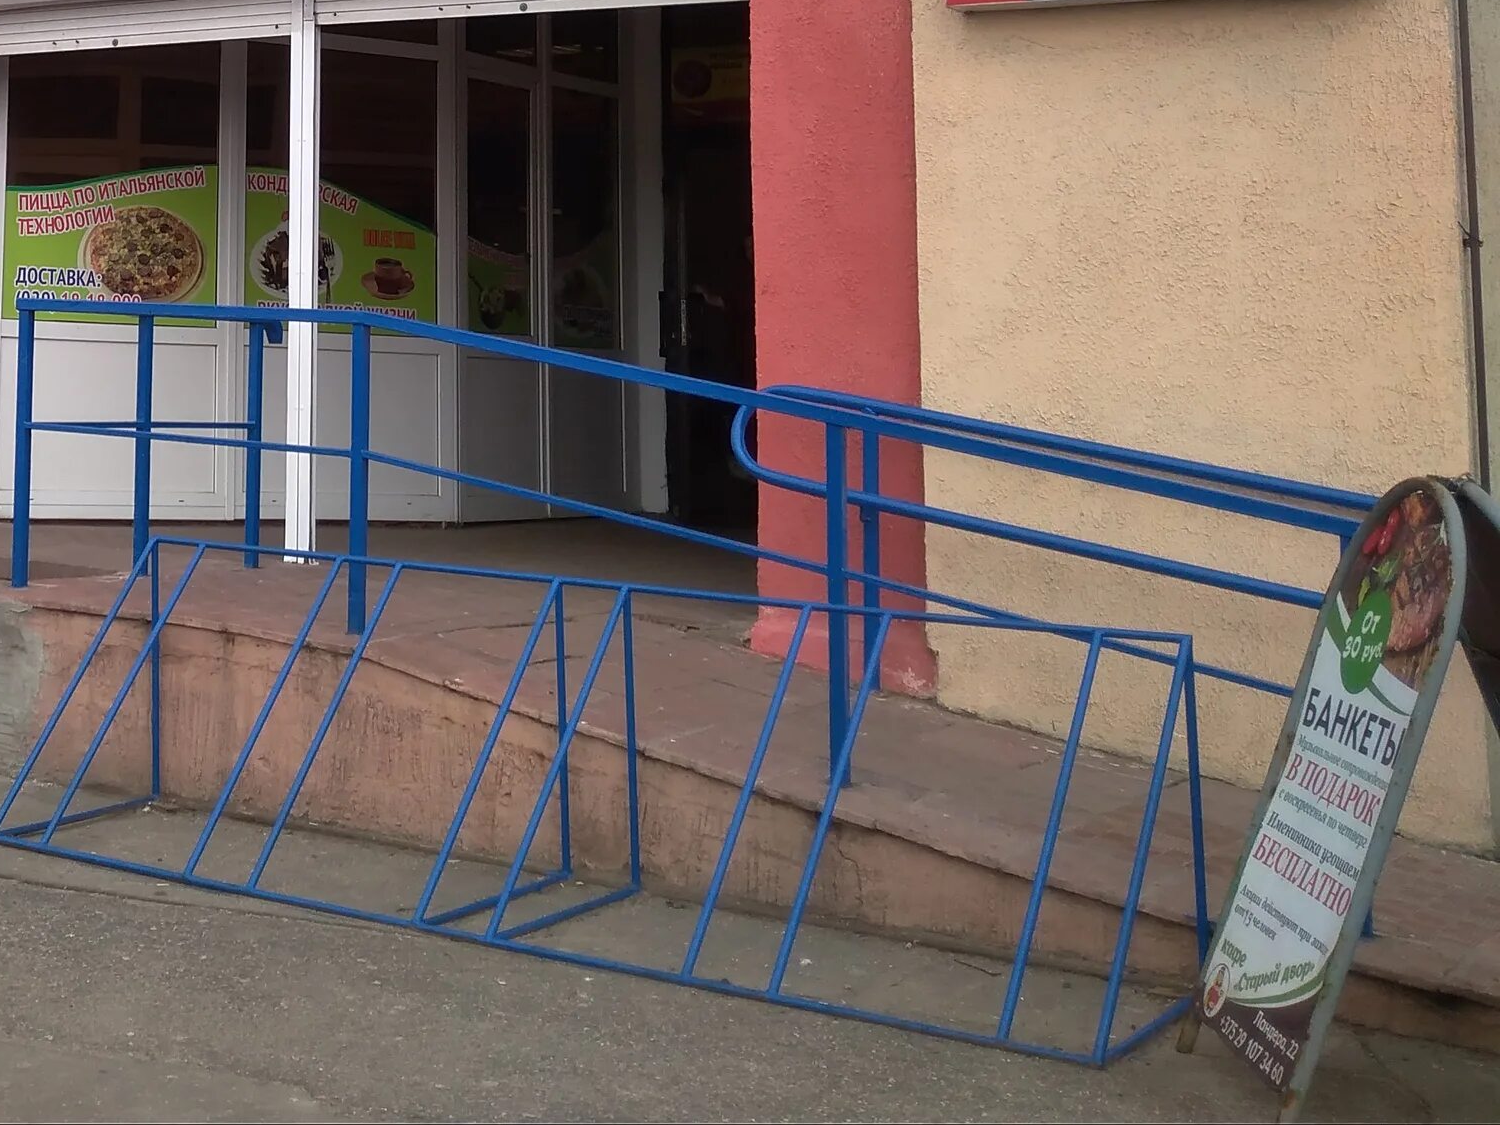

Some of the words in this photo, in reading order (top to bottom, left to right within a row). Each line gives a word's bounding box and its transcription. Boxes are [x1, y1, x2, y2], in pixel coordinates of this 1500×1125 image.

[18, 192, 71, 213] ПИЦЦА
[74, 189, 95, 206] ПО
[98, 167, 206, 201] ИТАЛЬЯНСКОЙ
[247, 174, 359, 214] КОНДСКАЯ
[17, 206, 115, 236] ТЕХНОЛОГИИ
[15, 266, 102, 288] ДОСТАВКА:
[1343, 635, 1362, 658] 30
[1302, 687, 1407, 770] БАНКЕТЫ
[1285, 753, 1303, 781] В
[1298, 759, 1381, 827] ПОДАРОК
[1326, 813, 1337, 829] по
[1252, 833, 1352, 916] БЕСПЛАТНО
[1219, 1016, 1239, 1041] +375
[1233, 1028, 1248, 1049] 29
[1245, 1038, 1264, 1063] 107
[1259, 1051, 1274, 1075] 34
[1271, 1063, 1285, 1085] 60
[1286, 1040, 1299, 1060] 22
